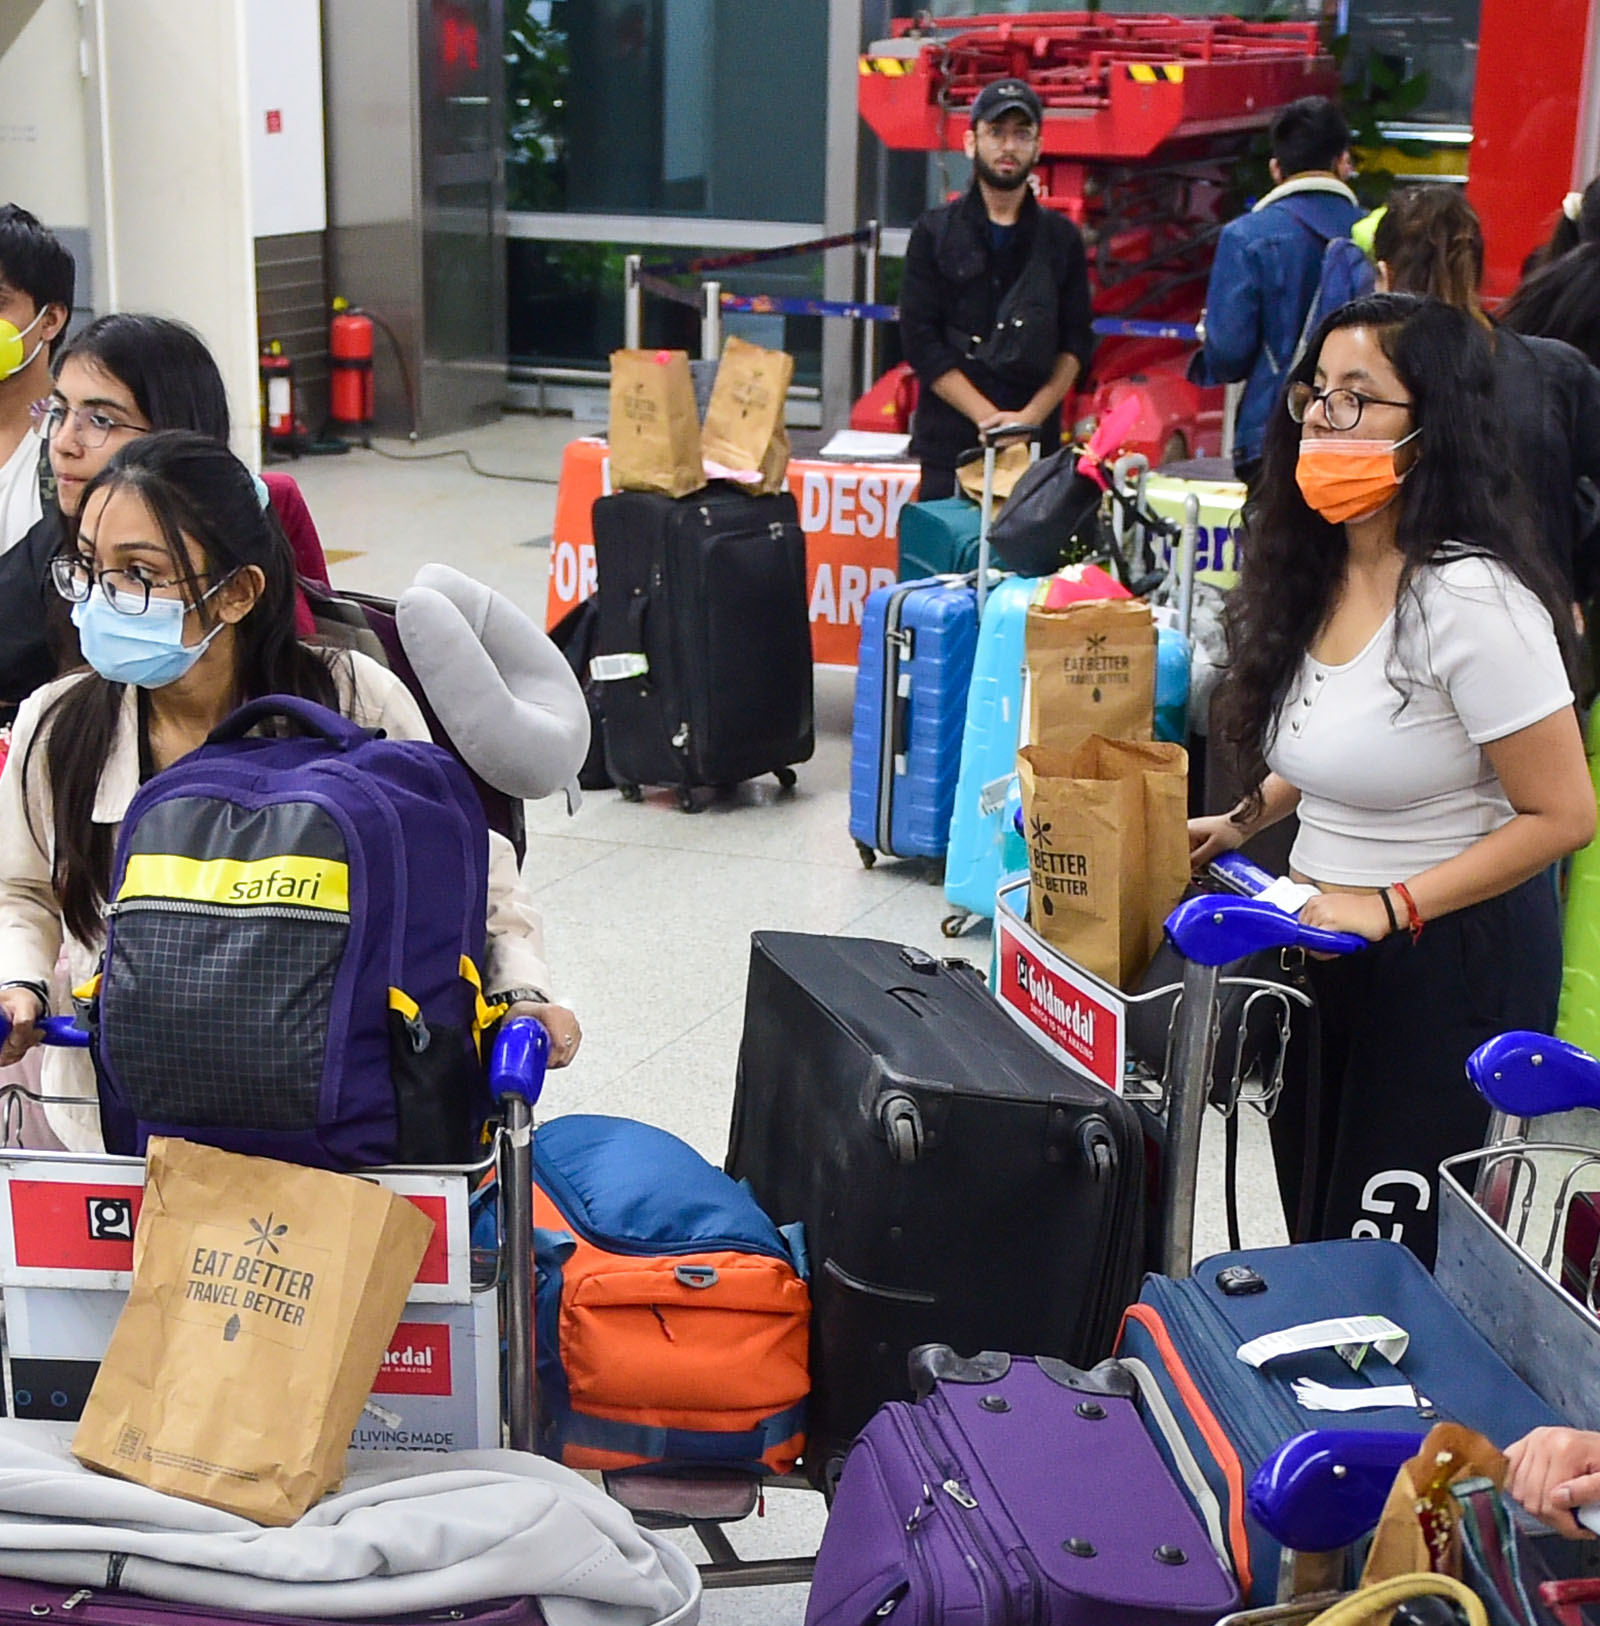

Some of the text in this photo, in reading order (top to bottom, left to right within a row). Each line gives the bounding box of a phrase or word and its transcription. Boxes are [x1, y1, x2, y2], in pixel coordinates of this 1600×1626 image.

[1033, 848, 1088, 877] BETTER
[228, 869, 322, 901] safari
[1045, 876, 1088, 896] BETTER
[1029, 964, 1095, 1048] Goldmedal
[191, 1247, 315, 1301] EAT BETTER
[186, 1280, 306, 1327] TRAVEL BETTER
[360, 1430, 409, 1444] LIVING
[411, 1432, 454, 1445] MADE
